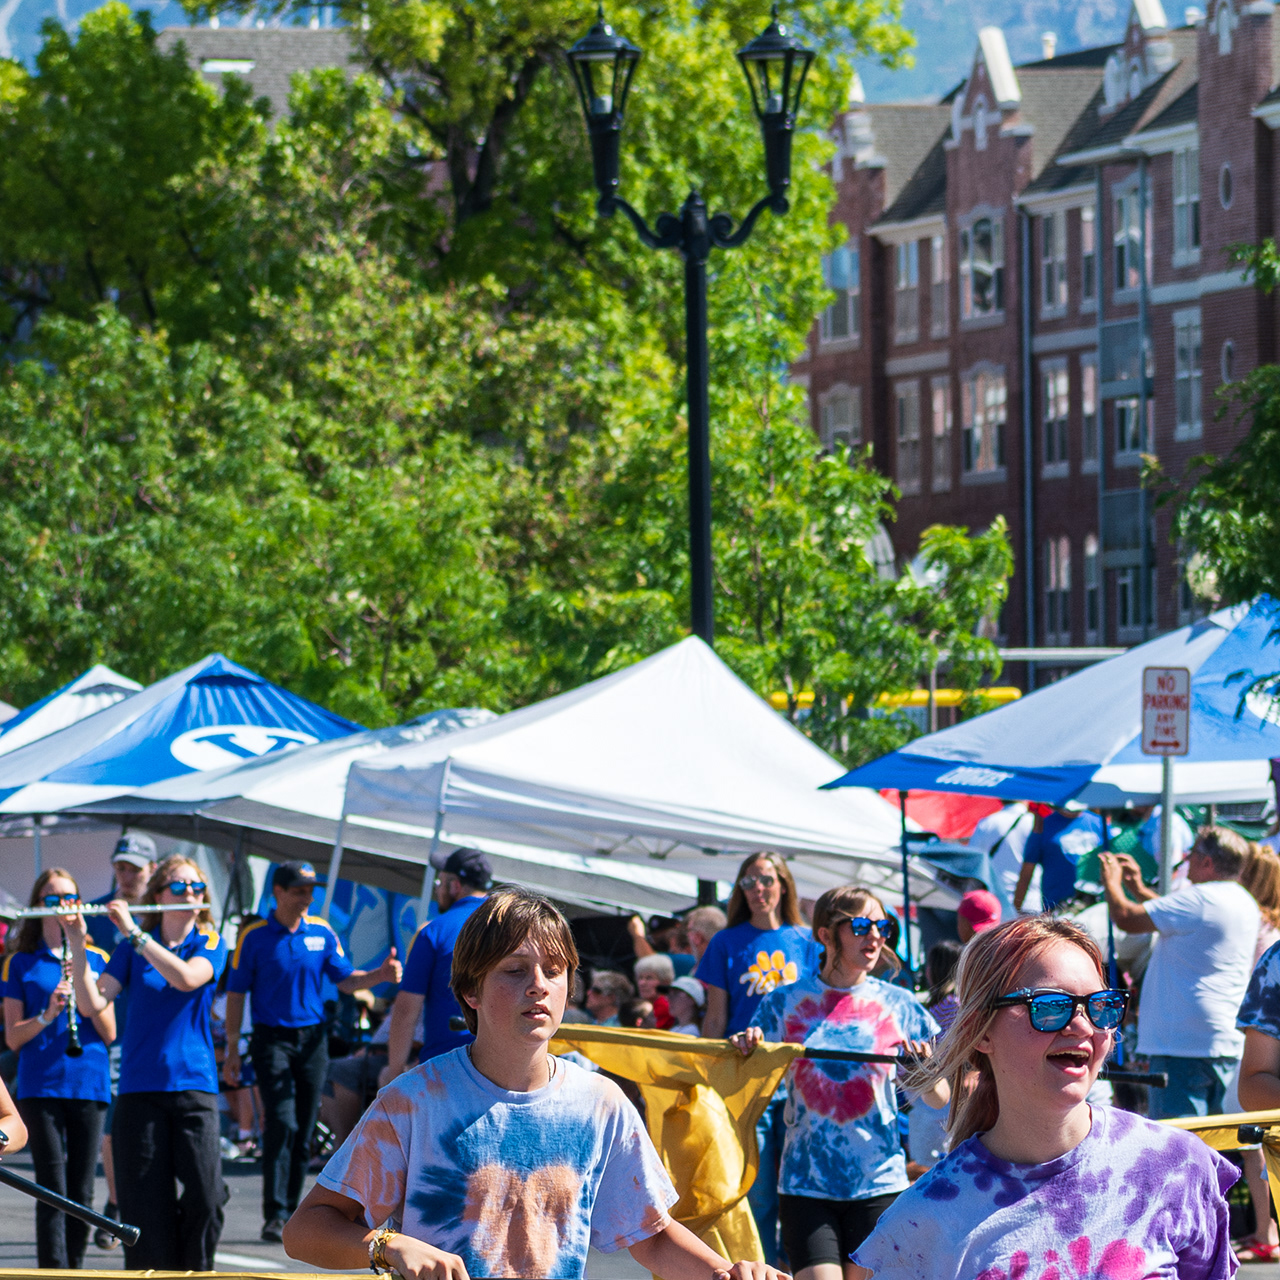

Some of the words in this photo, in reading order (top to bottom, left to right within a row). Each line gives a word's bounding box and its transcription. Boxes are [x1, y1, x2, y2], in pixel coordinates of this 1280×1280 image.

[1157, 676, 1175, 692] NO
[1144, 694, 1189, 710] PARKING
[1157, 713, 1175, 723] ANY
[1155, 727, 1176, 738] TIME
